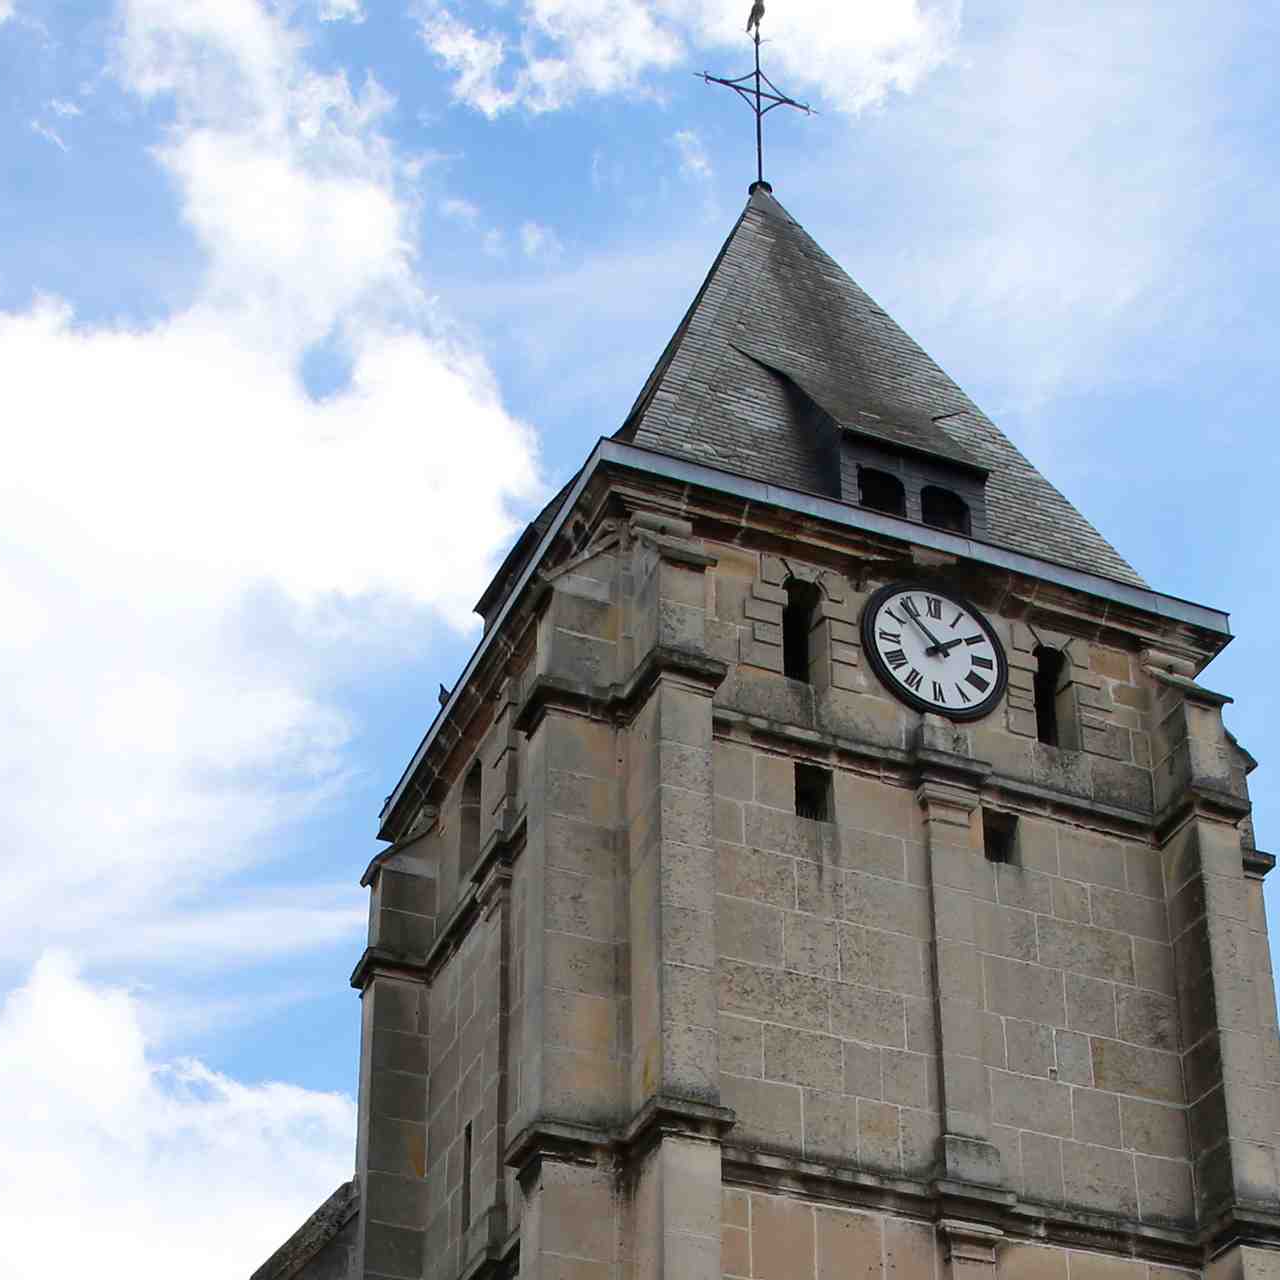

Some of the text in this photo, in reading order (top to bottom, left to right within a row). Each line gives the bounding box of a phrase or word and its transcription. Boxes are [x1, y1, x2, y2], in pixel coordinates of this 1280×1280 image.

[885, 609, 906, 625] X
[926, 596, 943, 620] XII
[950, 612, 964, 629] I
[879, 629, 901, 645] IX
[964, 634, 986, 646] II
[884, 649, 909, 671] VIII
[971, 654, 994, 670] III
[904, 669, 924, 692] VII
[932, 681, 946, 703] VI
[955, 683, 971, 703] V
